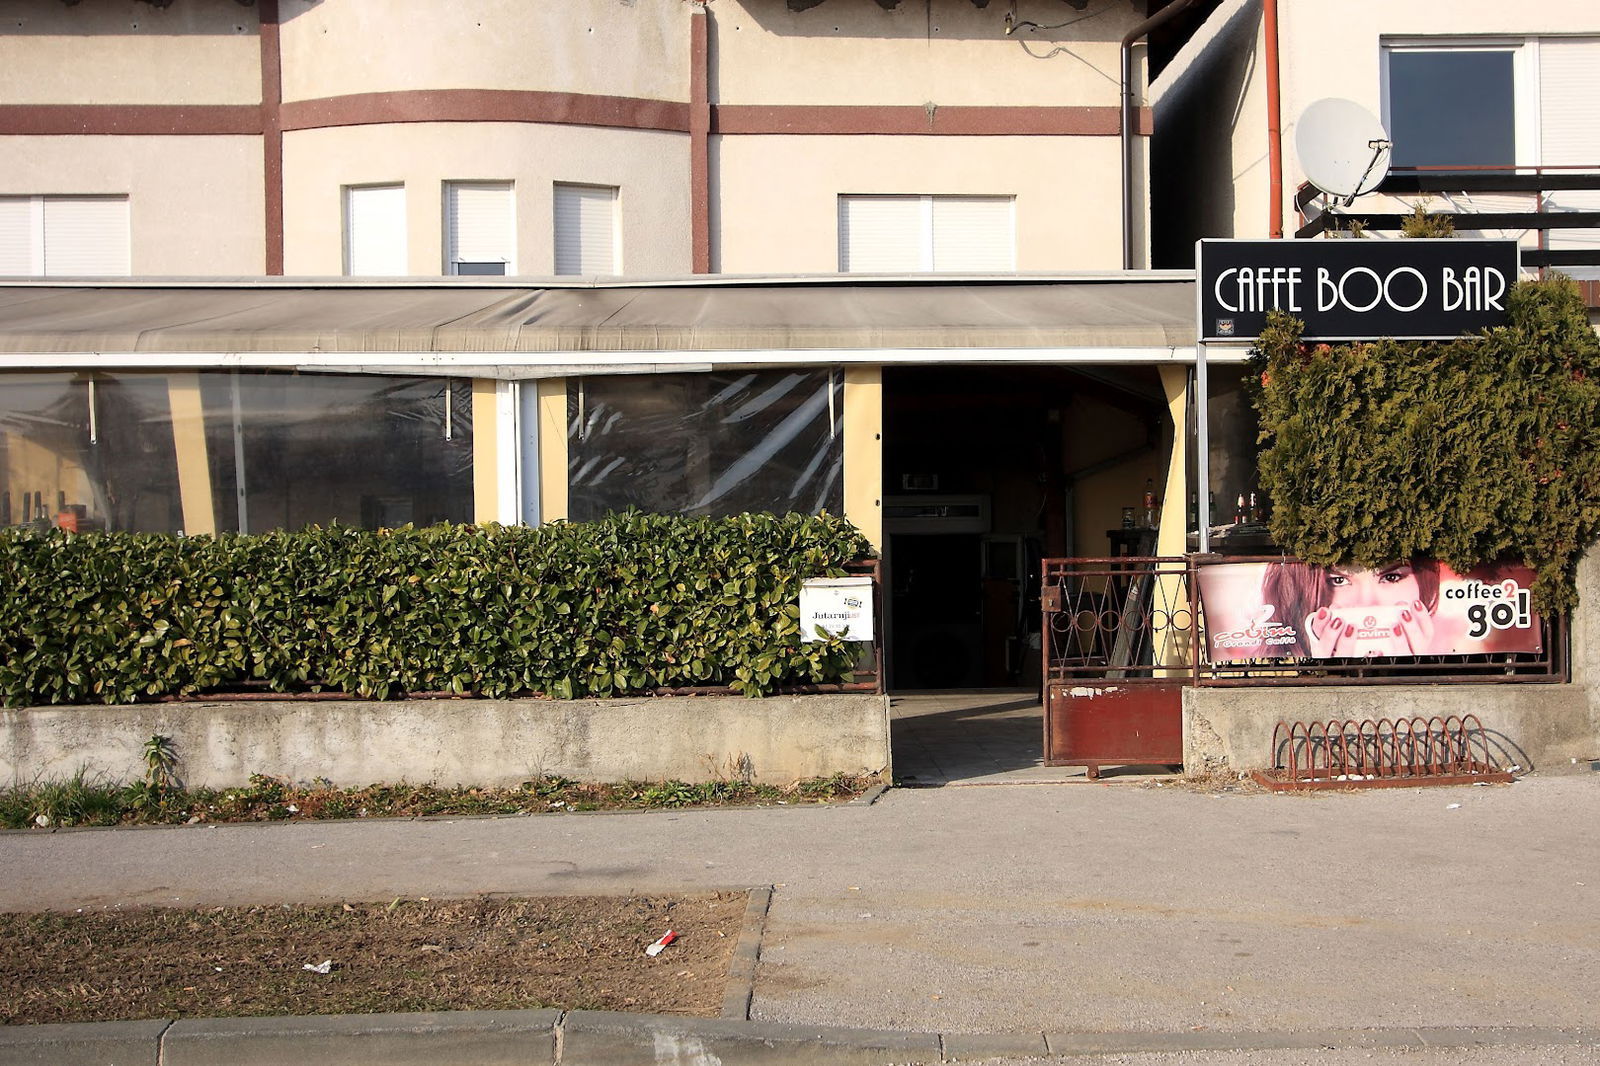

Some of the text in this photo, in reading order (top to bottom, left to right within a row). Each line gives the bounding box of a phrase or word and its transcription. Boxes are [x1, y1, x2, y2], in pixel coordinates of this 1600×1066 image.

[1214, 266, 1506, 312] CAFFE BOO BAR
[1467, 592, 1528, 638] go!
